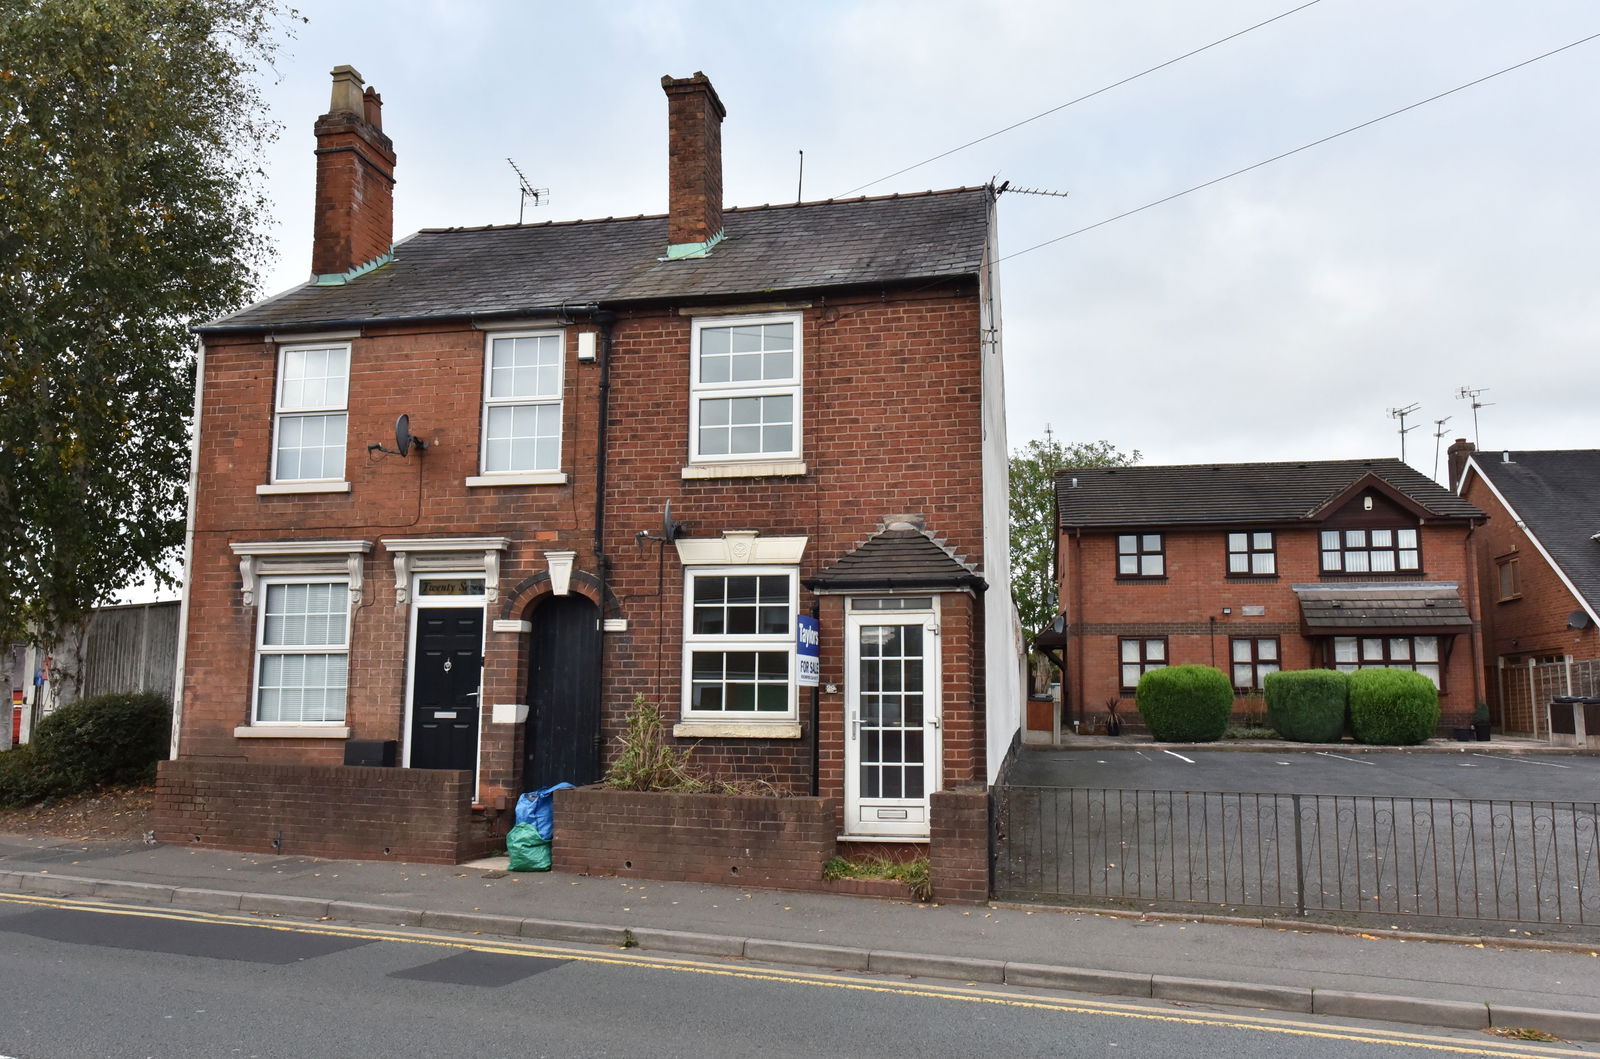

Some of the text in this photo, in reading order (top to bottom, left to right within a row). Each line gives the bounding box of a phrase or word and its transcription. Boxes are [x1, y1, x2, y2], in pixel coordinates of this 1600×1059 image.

[423, 581, 457, 593] Twenty
[798, 623, 819, 647] Taylors
[800, 660, 819, 674] FOR SALE
